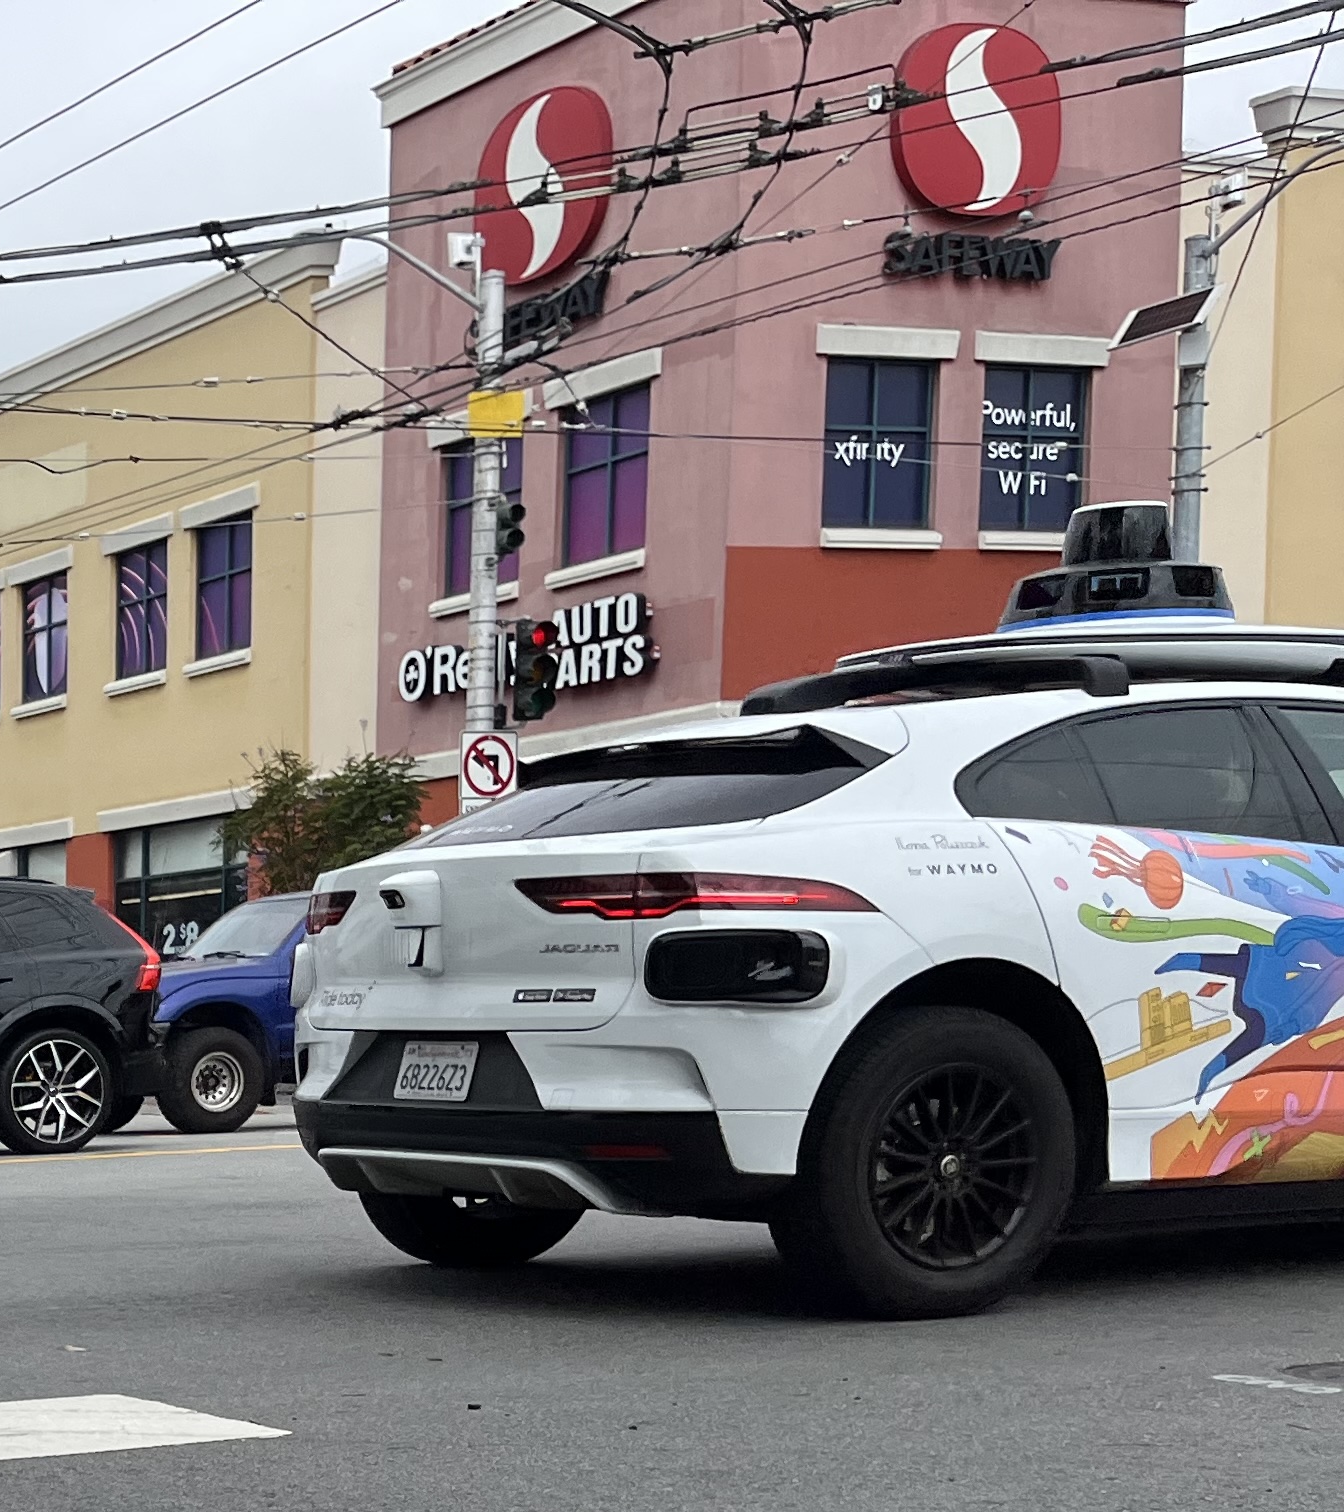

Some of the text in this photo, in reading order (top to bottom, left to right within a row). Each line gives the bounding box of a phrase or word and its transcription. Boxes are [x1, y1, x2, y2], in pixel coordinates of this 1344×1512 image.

[883, 231, 1062, 280] SAFEWAY
[547, 592, 639, 649] AUTO
[926, 863, 998, 875] WAYMO
[163, 923, 176, 955] 2
[539, 943, 620, 954] JAGUAR
